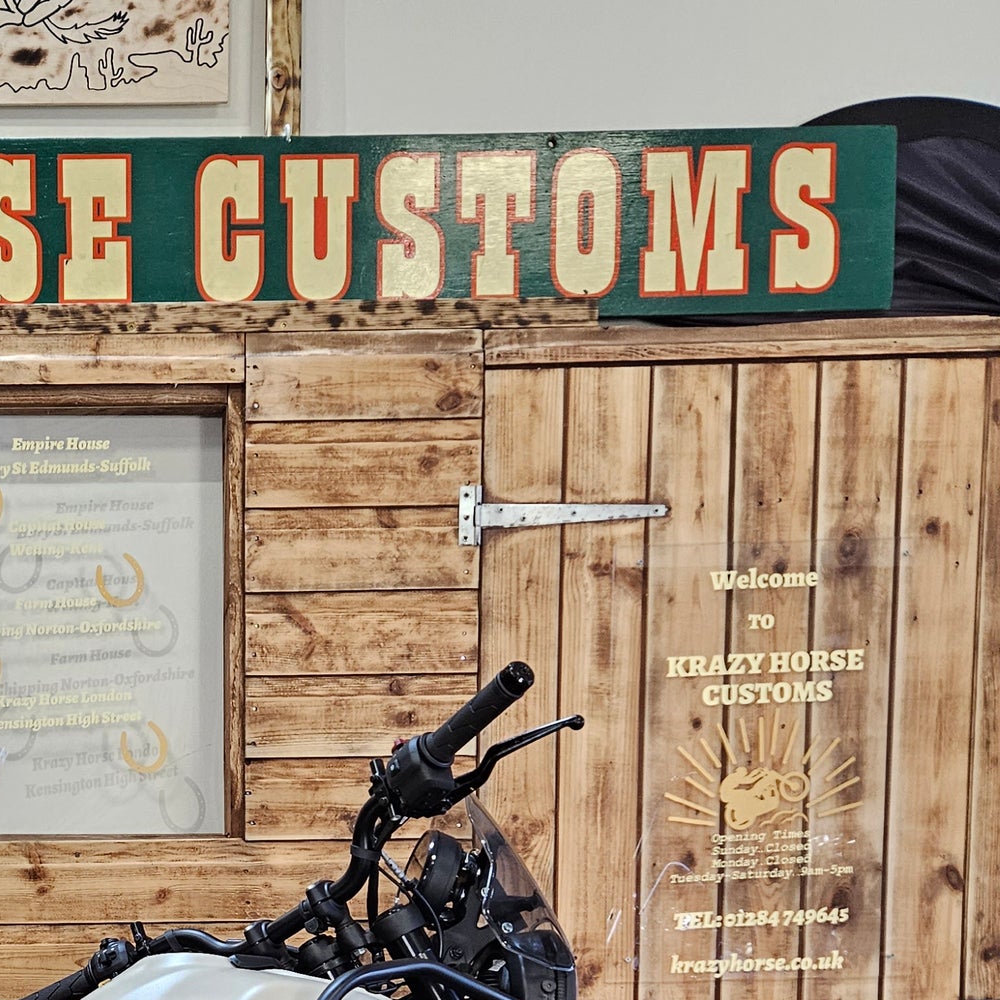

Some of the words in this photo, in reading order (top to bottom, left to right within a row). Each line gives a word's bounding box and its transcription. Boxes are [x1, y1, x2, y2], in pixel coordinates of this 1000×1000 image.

[197, 142, 839, 303] CUSTOMS
[12, 436, 64, 455] Empire
[65, 437, 110, 450] House
[11, 461, 27, 474] St
[29, 457, 152, 475] Edmunds-Suffolk
[710, 568, 819, 591] Welcome
[25, 618, 161, 637] Norton-Oxfordshire
[748, 614, 775, 630] TO
[666, 652, 765, 678] KRAZY
[769, 649, 865, 673] HORSE
[39, 693, 79, 705] Horse
[81, 689, 132, 702] London
[702, 680, 834, 706] CUSTOMS
[66, 713, 100, 727] High
[101, 711, 142, 723] Street
[711, 832, 766, 845] Opening
[773, 829, 811, 840] Times
[782, 906, 850, 927] 749645
[670, 950, 845, 978] krazyhorse.co.uk
